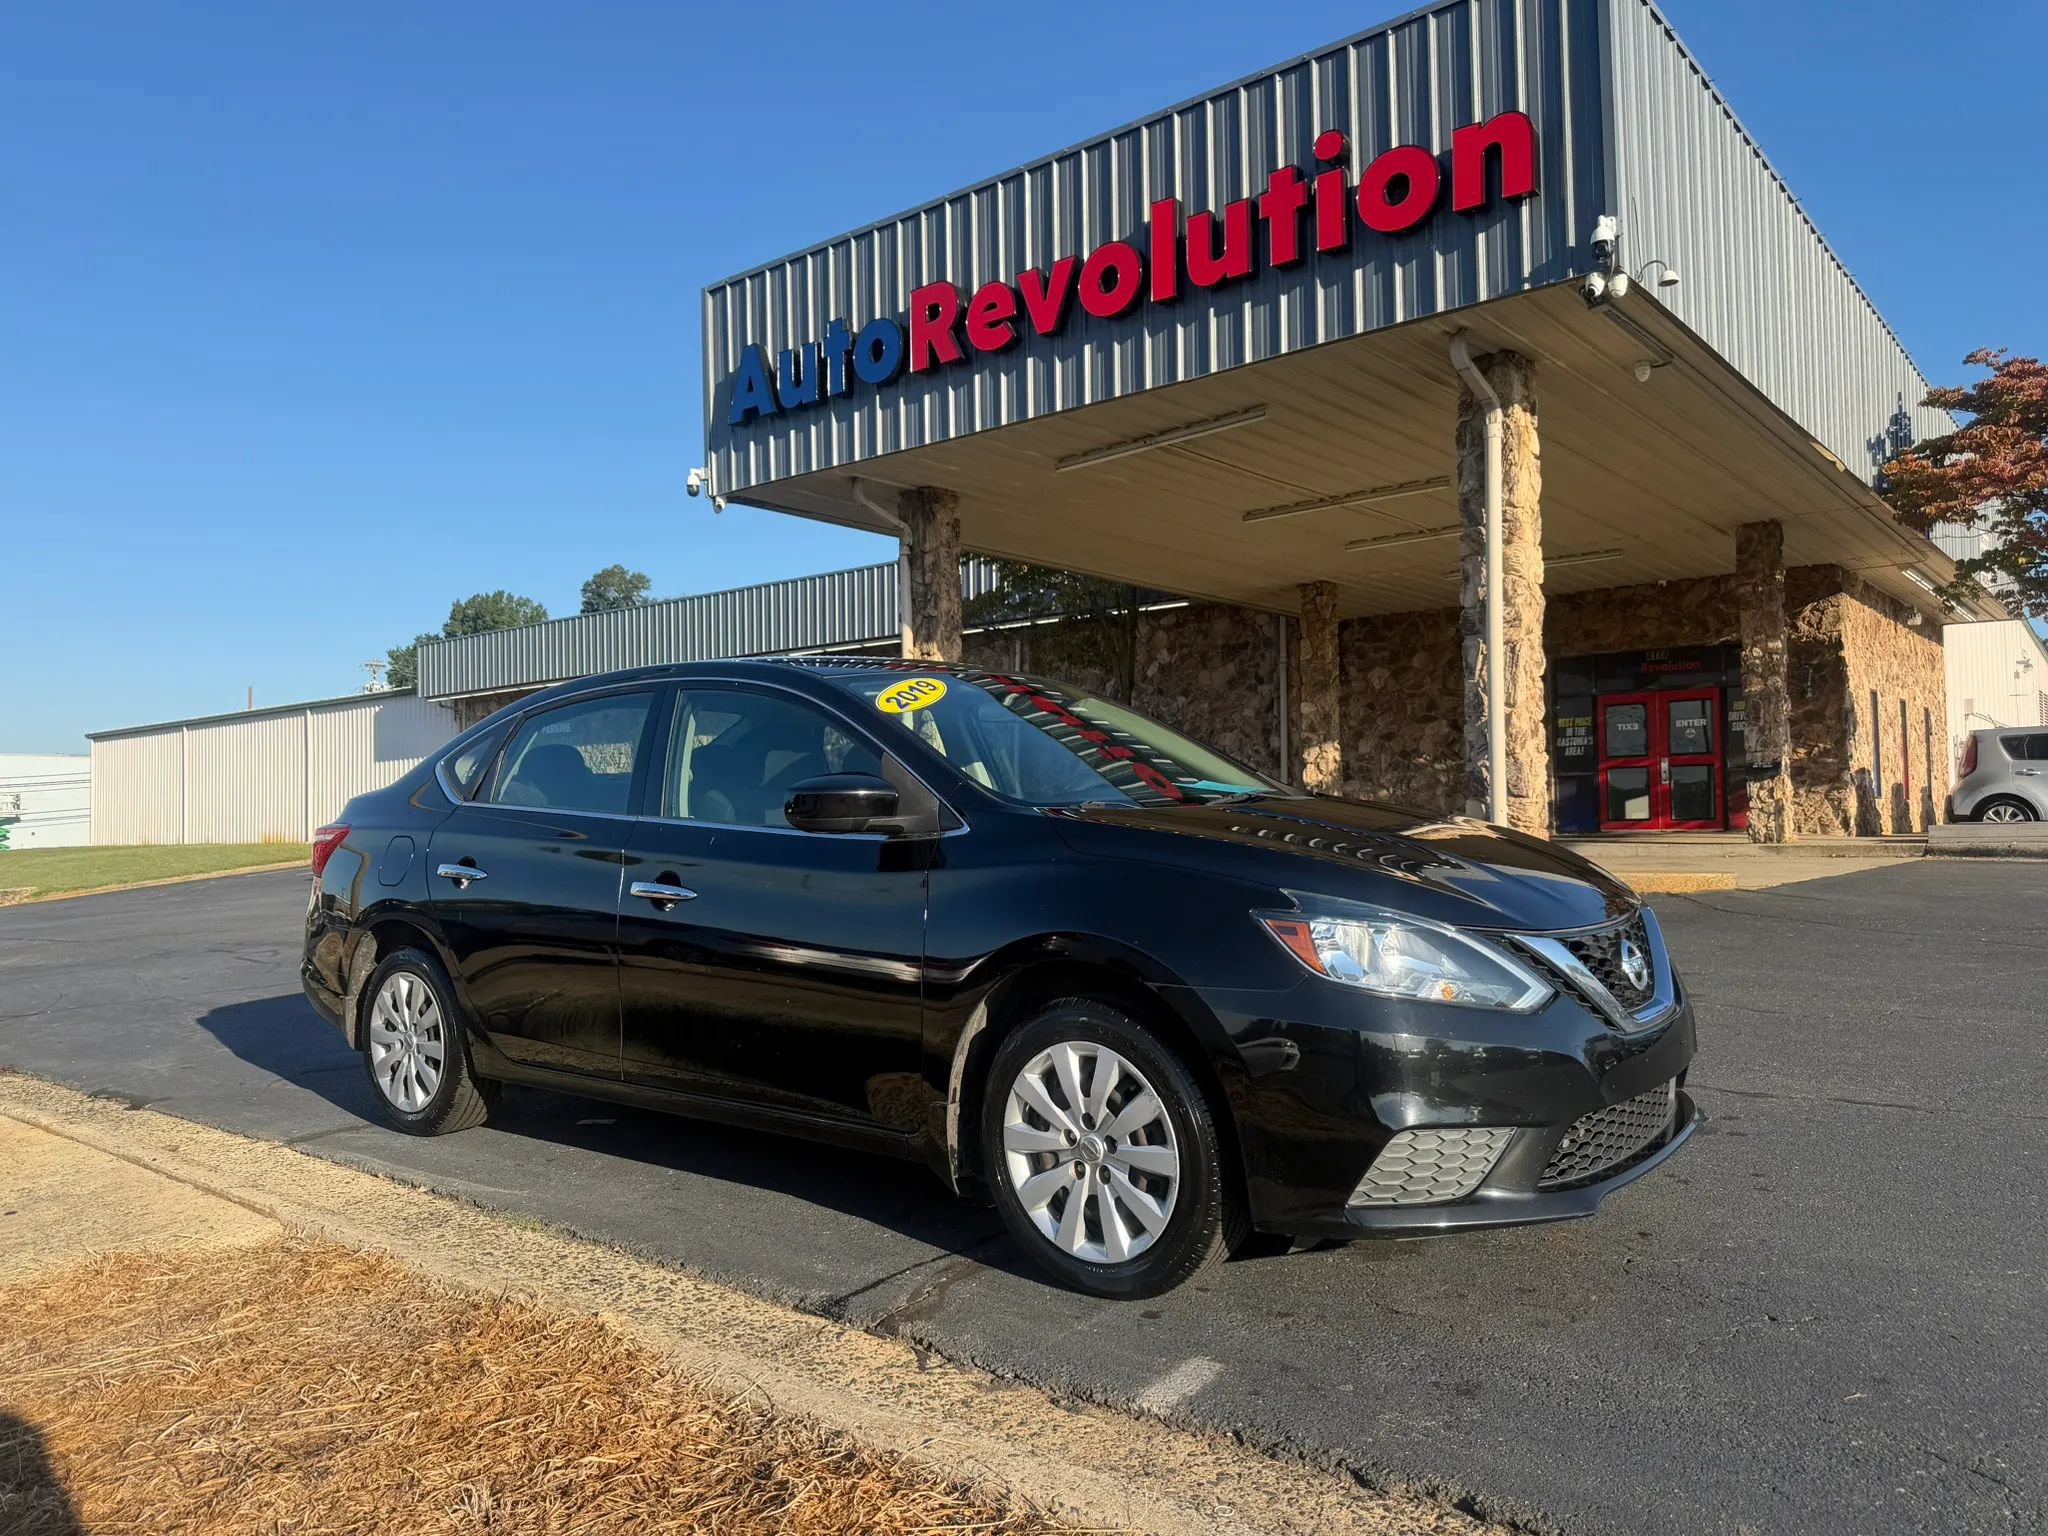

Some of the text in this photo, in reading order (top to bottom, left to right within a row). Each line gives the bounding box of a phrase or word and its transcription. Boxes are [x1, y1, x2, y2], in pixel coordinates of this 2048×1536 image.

[1641, 659, 1702, 673] Revolution
[885, 680, 938, 710] 2019
[541, 722, 571, 736] PARKING
[1675, 718, 1707, 728] ENTER
[1564, 746, 1585, 756] AREA!
